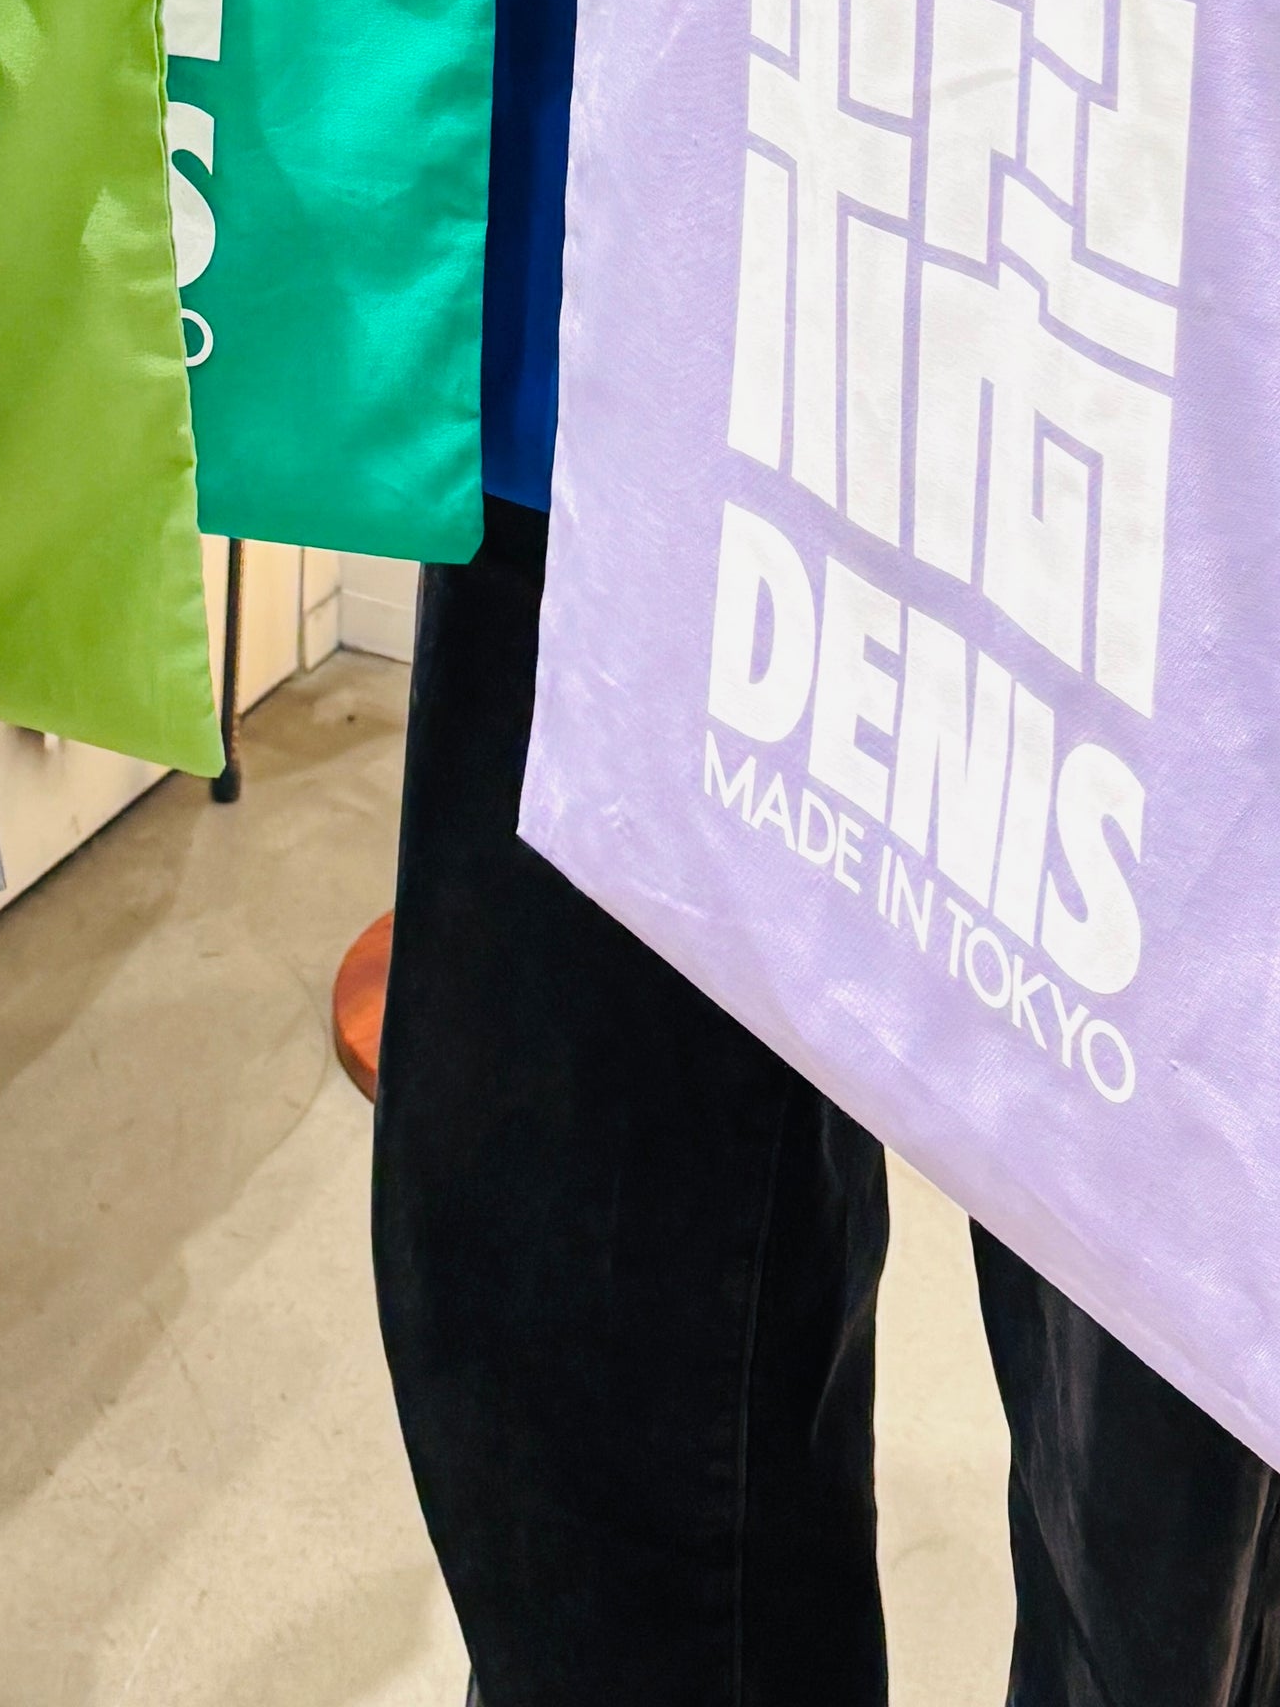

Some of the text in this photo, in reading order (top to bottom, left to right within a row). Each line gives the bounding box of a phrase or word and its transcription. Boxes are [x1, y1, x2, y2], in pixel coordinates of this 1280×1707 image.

[704, 730, 1136, 1104] MADE IN TOKYO
[707, 499, 1146, 995] DENIS
